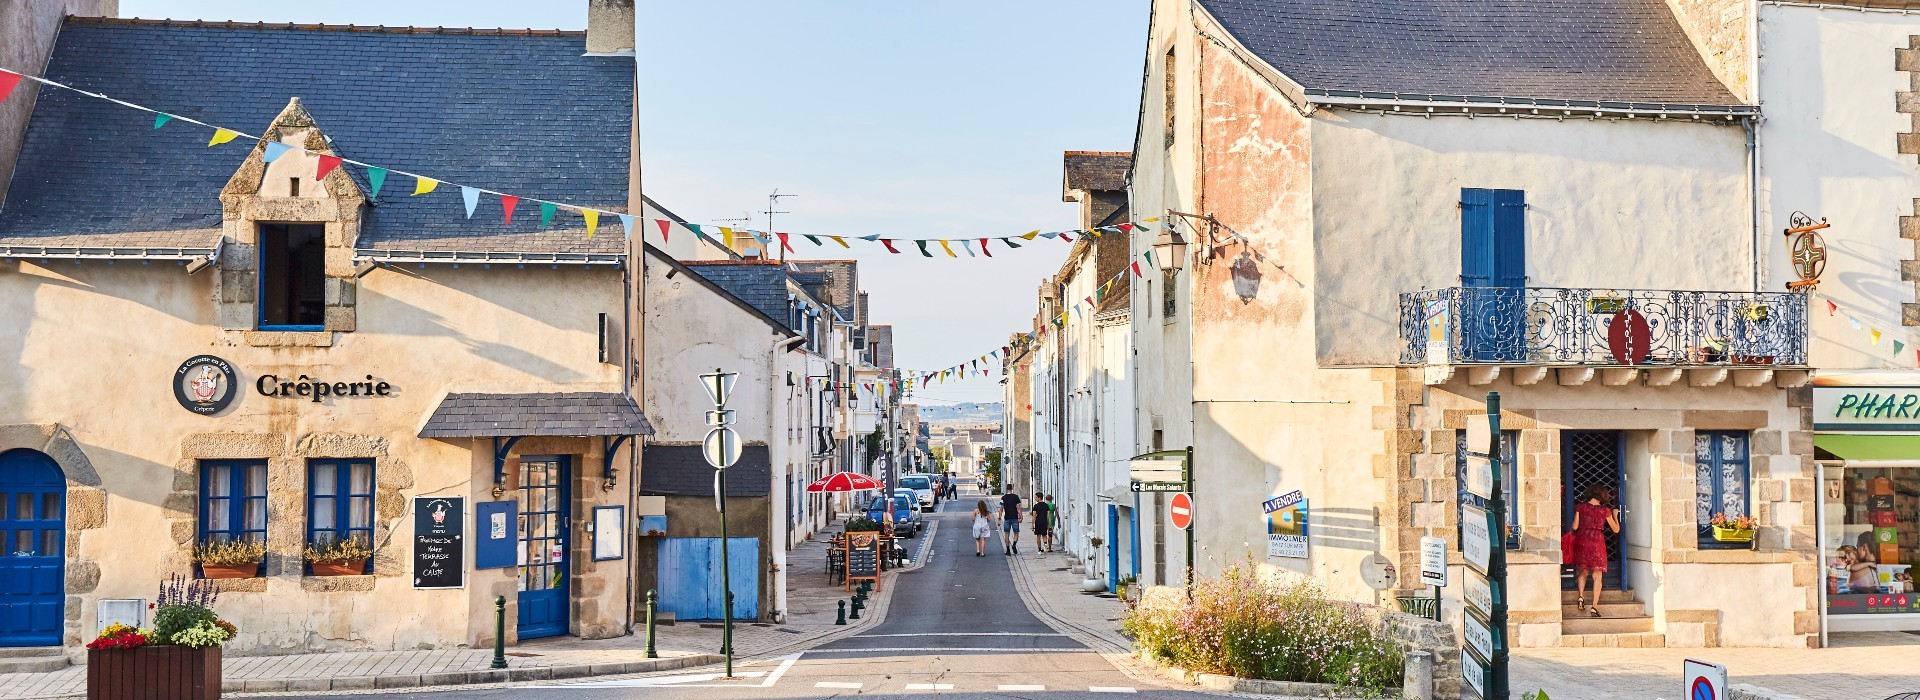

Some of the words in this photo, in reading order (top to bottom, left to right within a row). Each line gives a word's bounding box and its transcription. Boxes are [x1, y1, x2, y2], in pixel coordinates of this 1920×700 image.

[179, 366, 188, 374] La
[186, 357, 211, 367] Cocotte
[219, 361, 230, 375] Pâte
[256, 374, 391, 402] Crêperie
[1264, 502, 1272, 513] A
[1271, 491, 1302, 511] VENDRE
